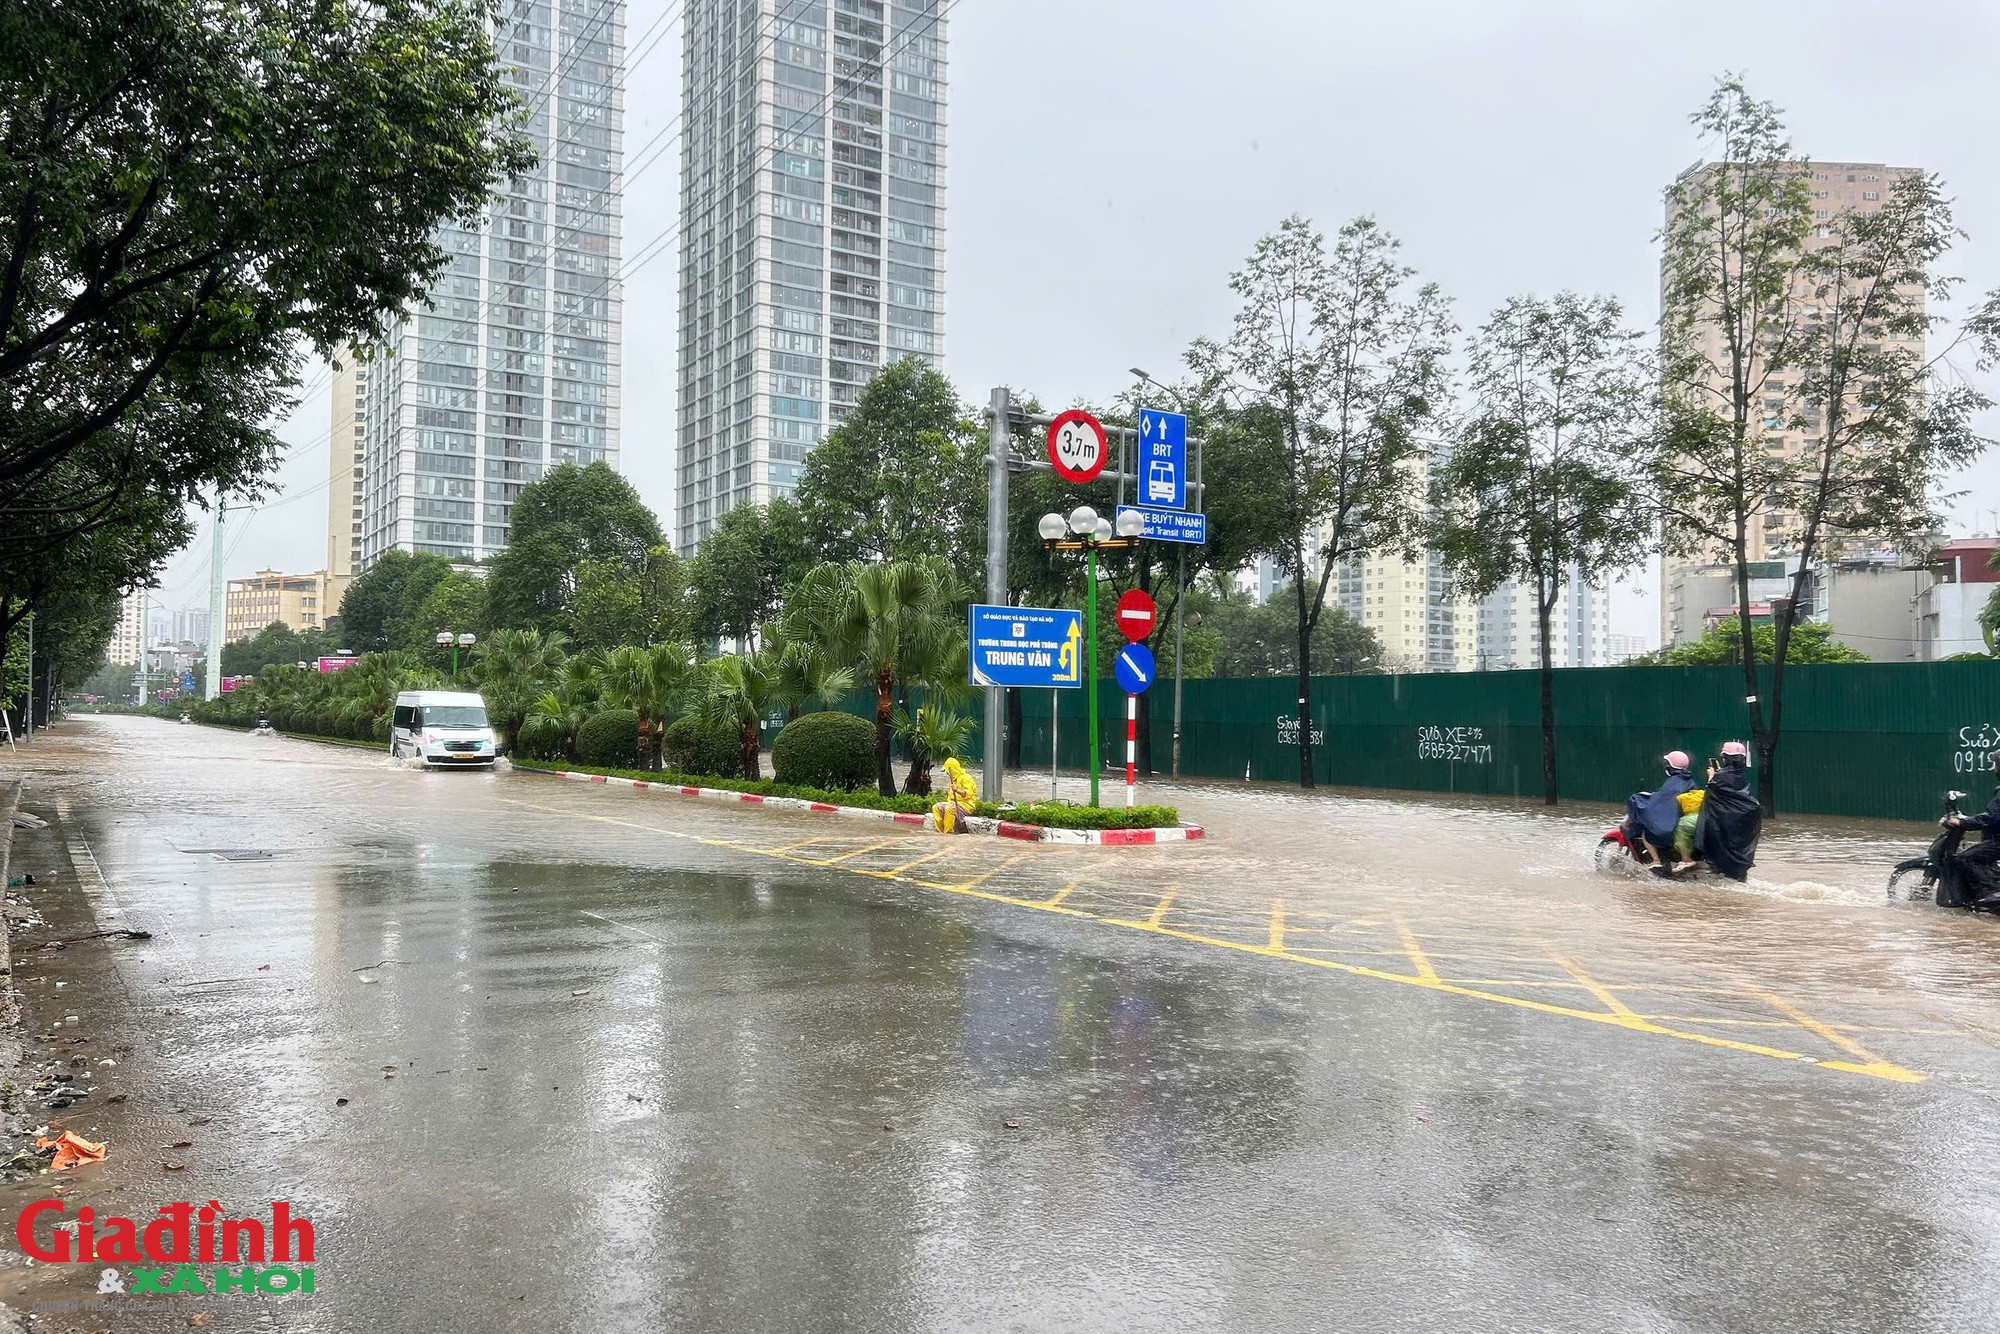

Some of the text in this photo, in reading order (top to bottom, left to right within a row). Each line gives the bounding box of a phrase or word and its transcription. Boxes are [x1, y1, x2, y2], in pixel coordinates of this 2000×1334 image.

[1152, 443, 1172, 457] BRT
[1152, 512, 1173, 525] BUÝT
[1175, 516, 1202, 528] NHANH
[1156, 526, 1179, 537] Transit
[1182, 529, 1202, 539] (BRT)
[985, 649, 1051, 667] TRUNG VĂN
